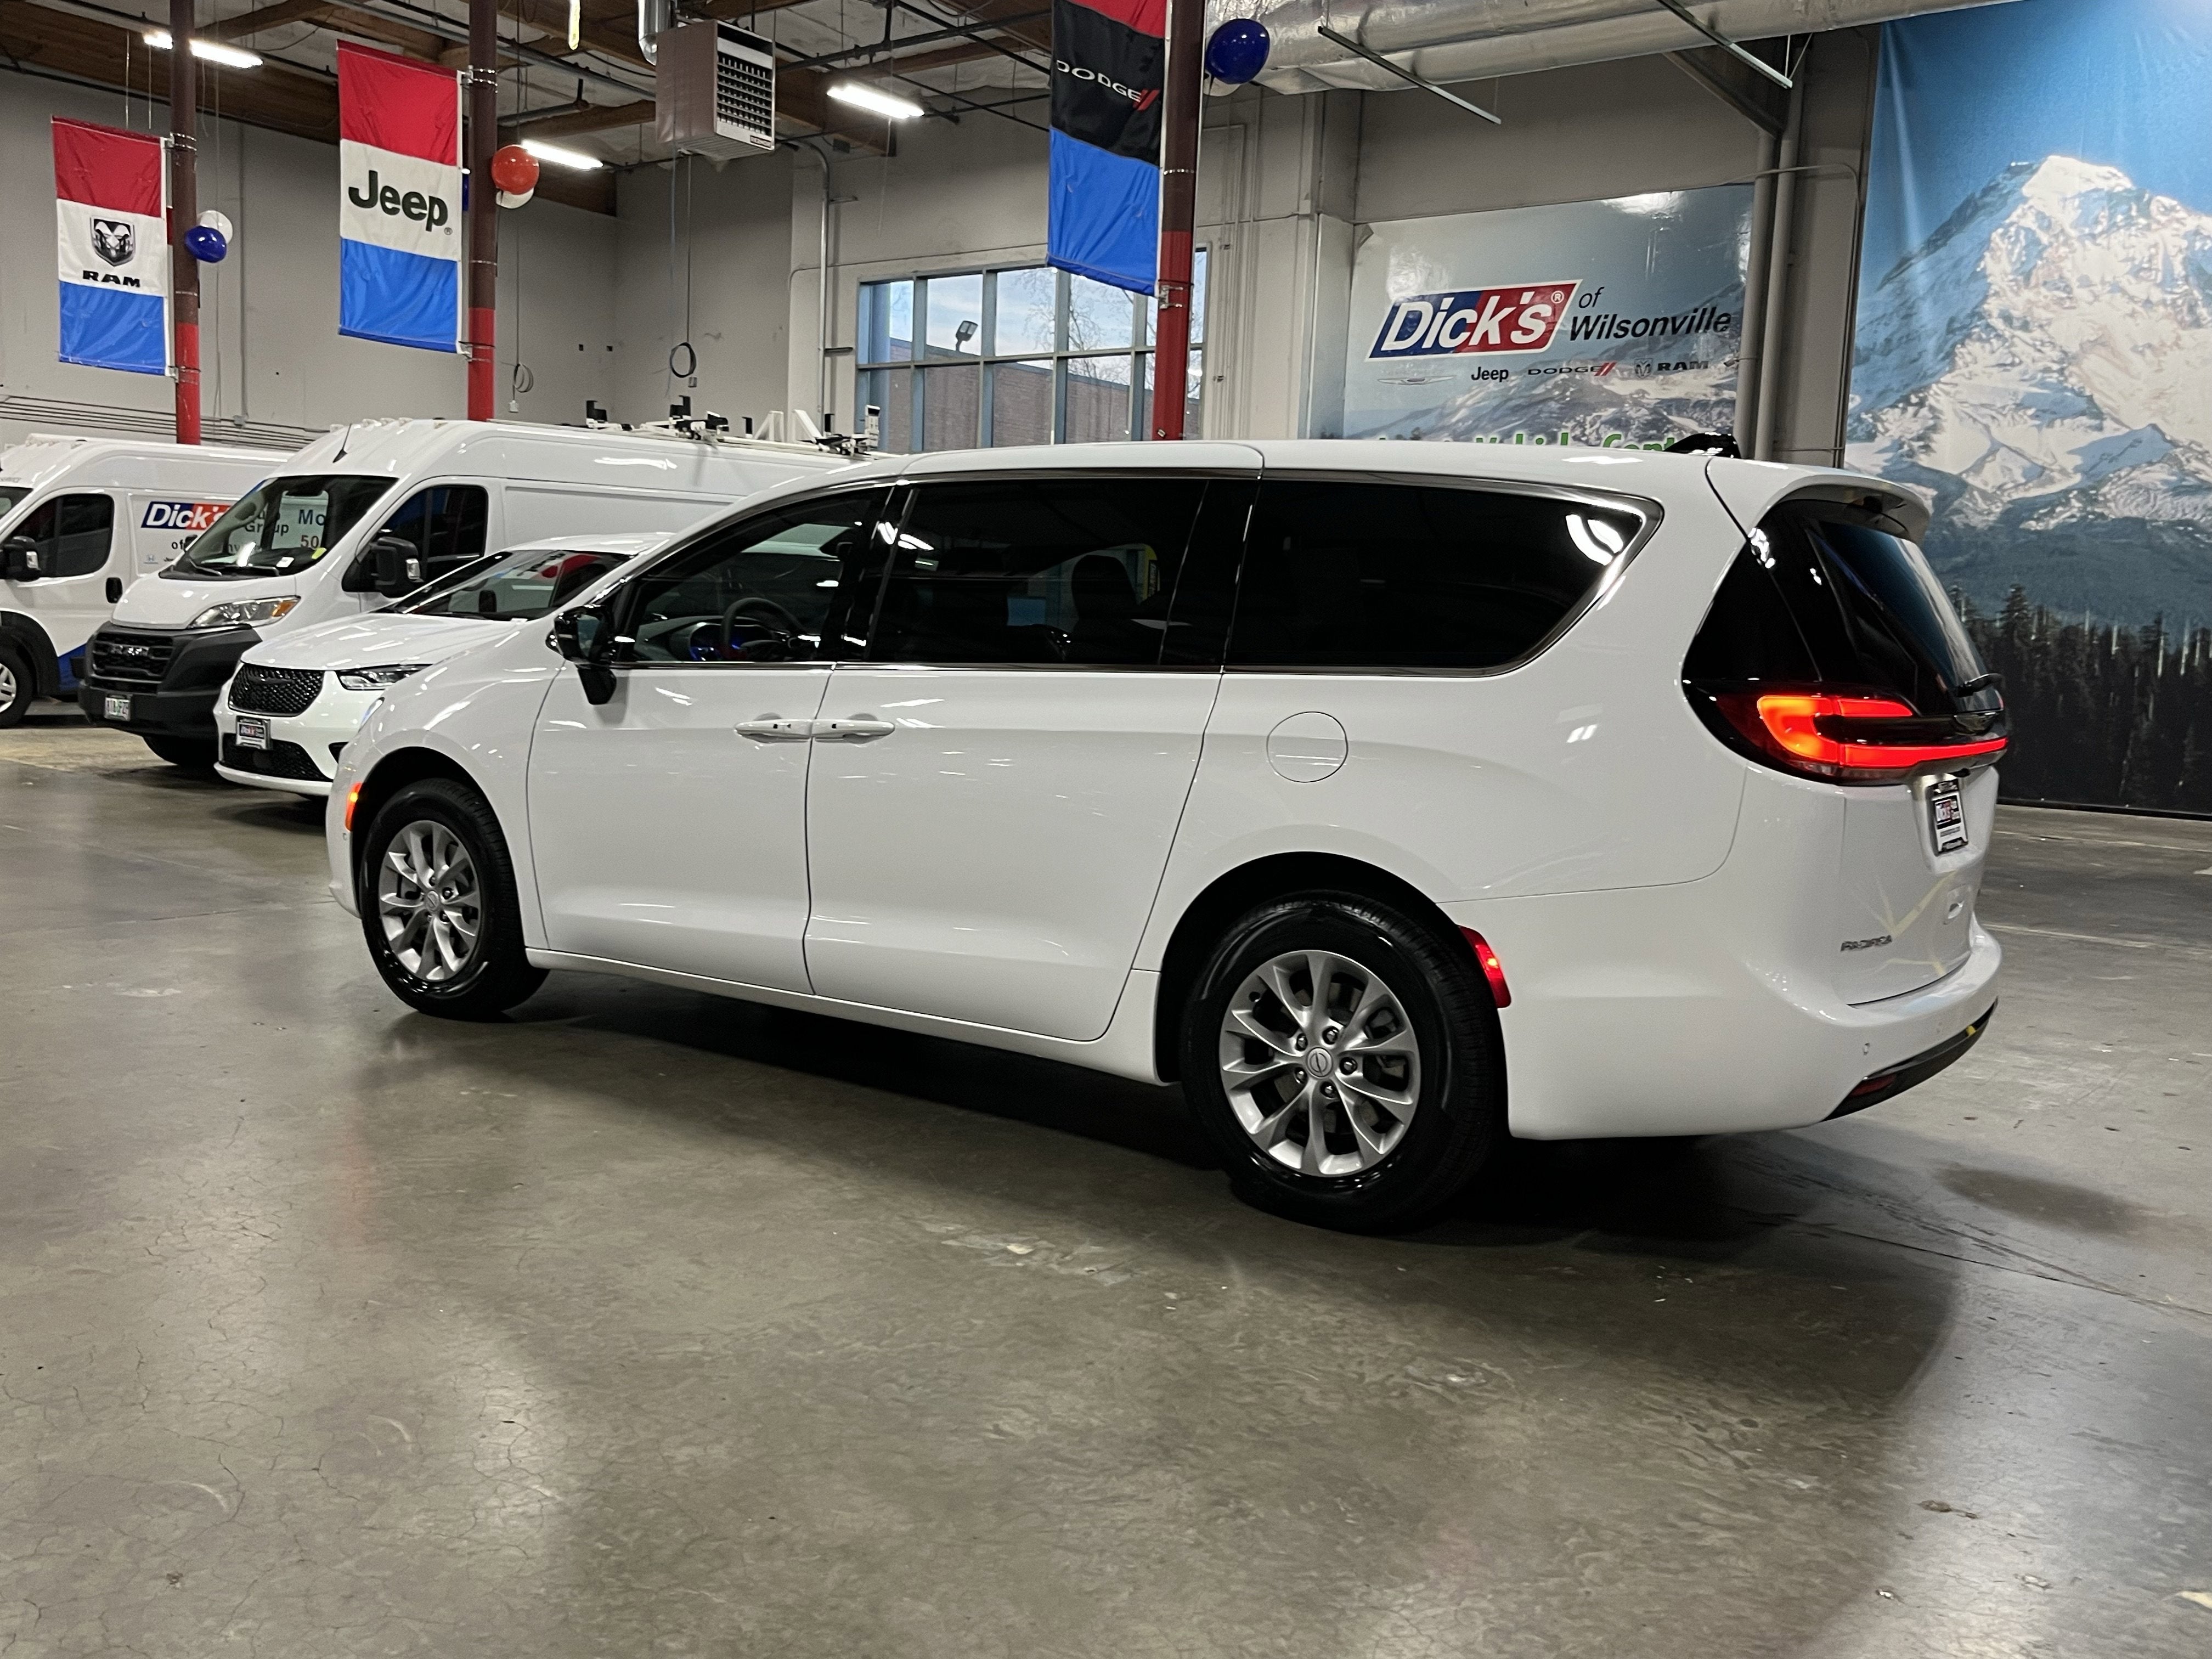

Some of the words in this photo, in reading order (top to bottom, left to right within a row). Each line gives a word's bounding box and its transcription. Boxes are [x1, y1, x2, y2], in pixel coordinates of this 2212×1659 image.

[1057, 60, 1142, 103] DODGE
[348, 170, 448, 232] Jeep
[83, 270, 140, 287] RAM
[1578, 286, 1605, 308] of
[1380, 291, 1553, 351] Dick's
[1570, 307, 1731, 341] Wilsonville
[1471, 366, 1509, 382] Jeep
[1528, 366, 1603, 375] DODGE
[1657, 360, 1709, 371] RAM
